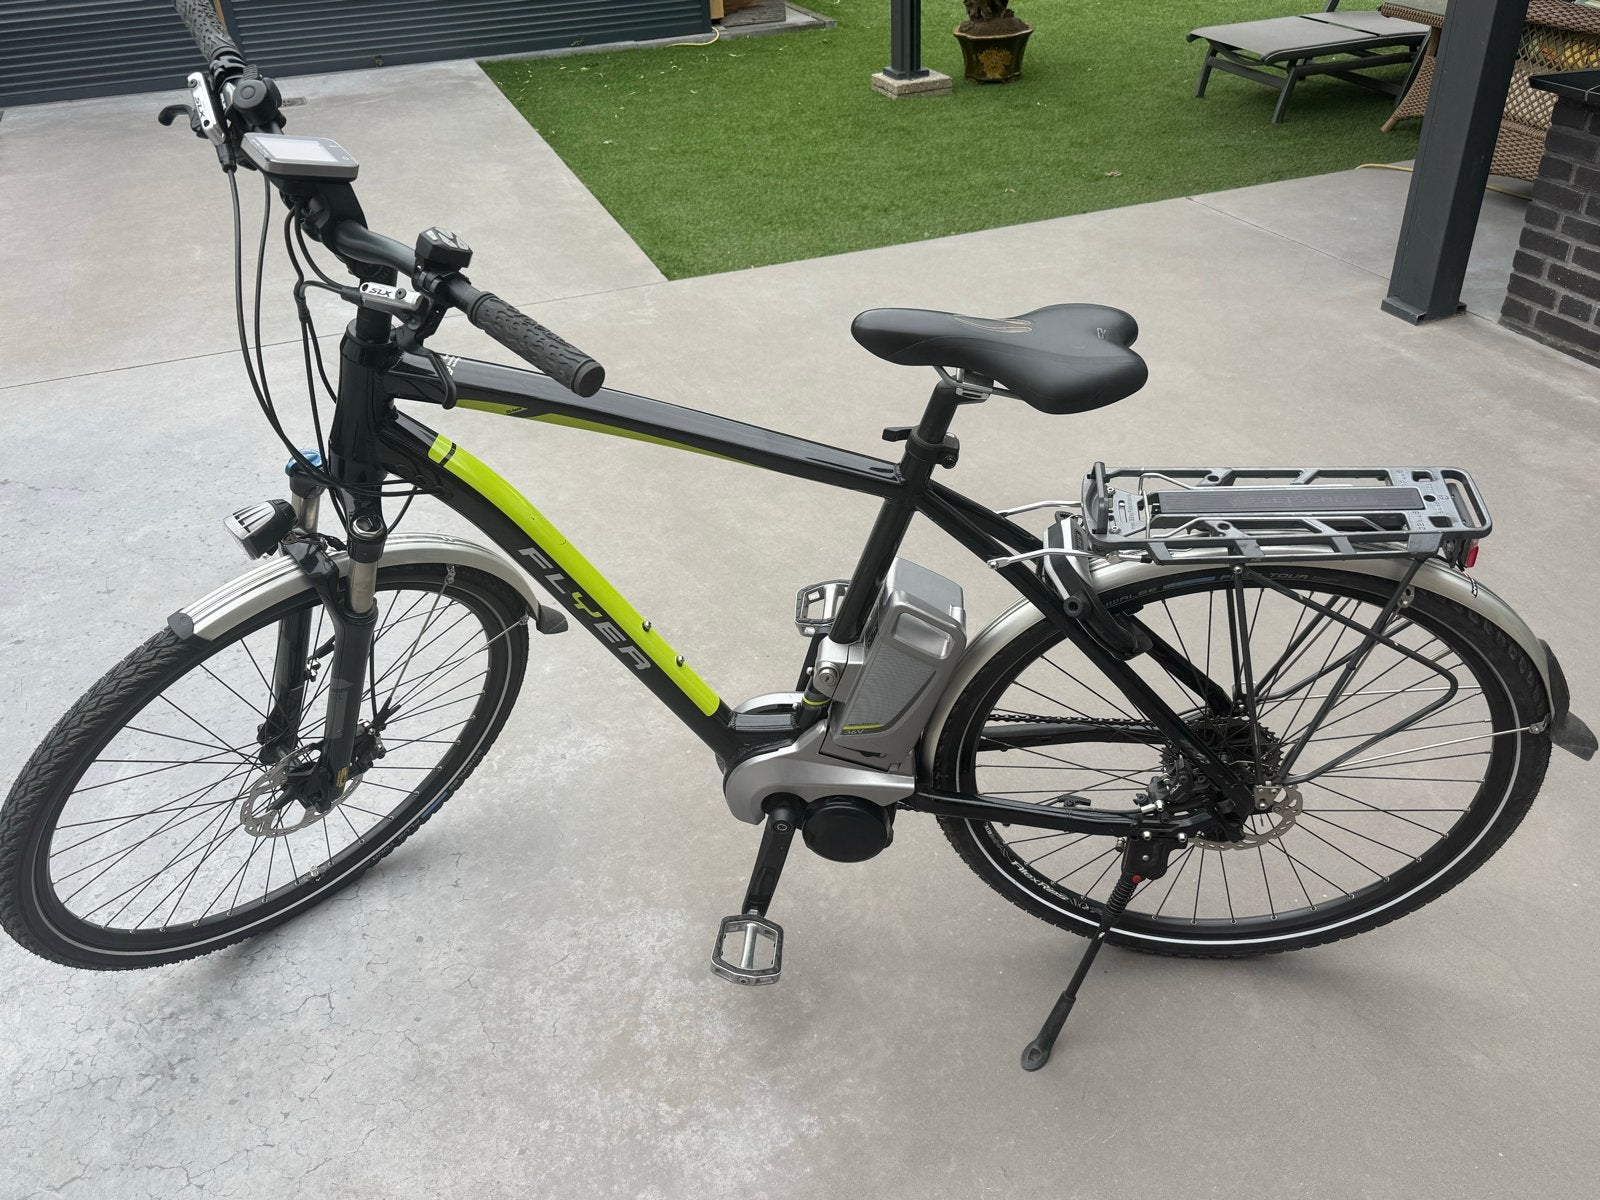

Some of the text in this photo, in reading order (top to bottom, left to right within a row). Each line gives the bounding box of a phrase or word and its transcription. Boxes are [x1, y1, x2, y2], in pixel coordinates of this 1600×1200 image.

[369, 287, 392, 298] SLX
[1270, 572, 1309, 580] TOUR
[517, 547, 652, 671] FLYER
